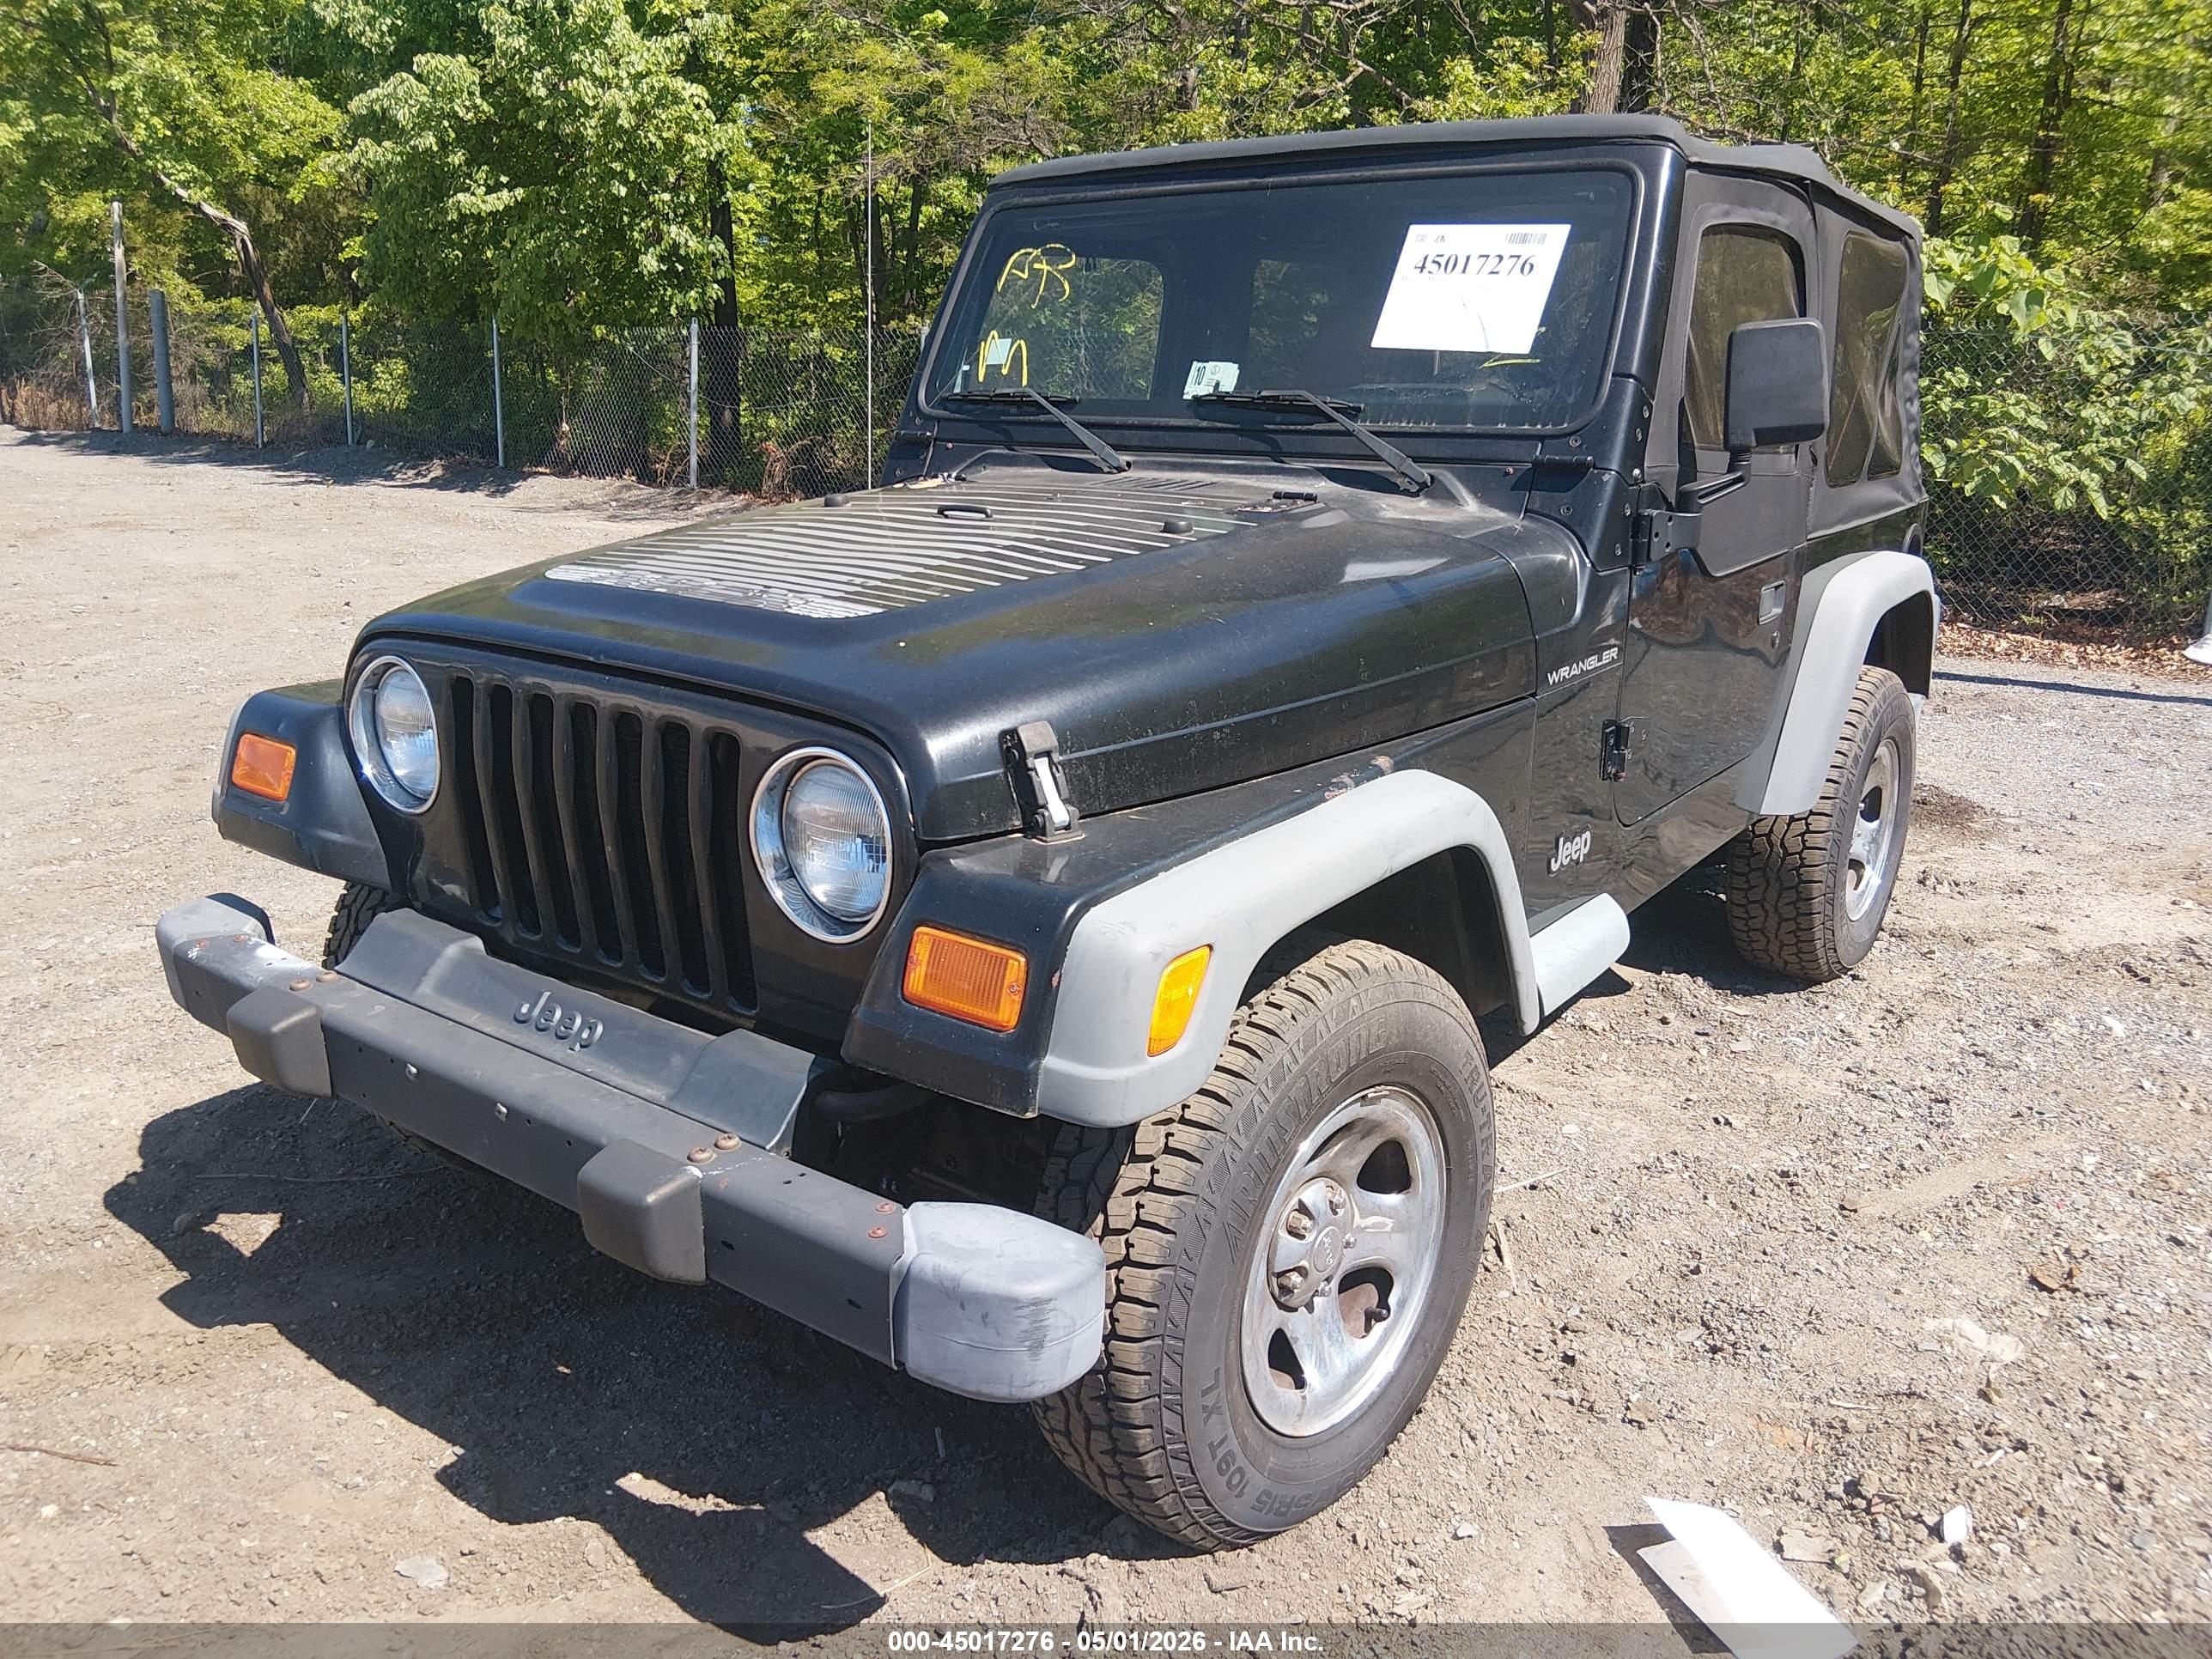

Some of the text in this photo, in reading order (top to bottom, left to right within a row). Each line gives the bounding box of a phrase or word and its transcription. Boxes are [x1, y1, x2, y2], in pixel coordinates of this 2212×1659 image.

[1413, 253, 1537, 276] 45017276
[1547, 647, 1619, 686] WRANGLER
[1550, 830, 1591, 872] Jeep
[513, 989, 605, 1053] Jeep
[1200, 1366, 1224, 1425] XL
[1208, 1432, 1251, 1499] 109T
